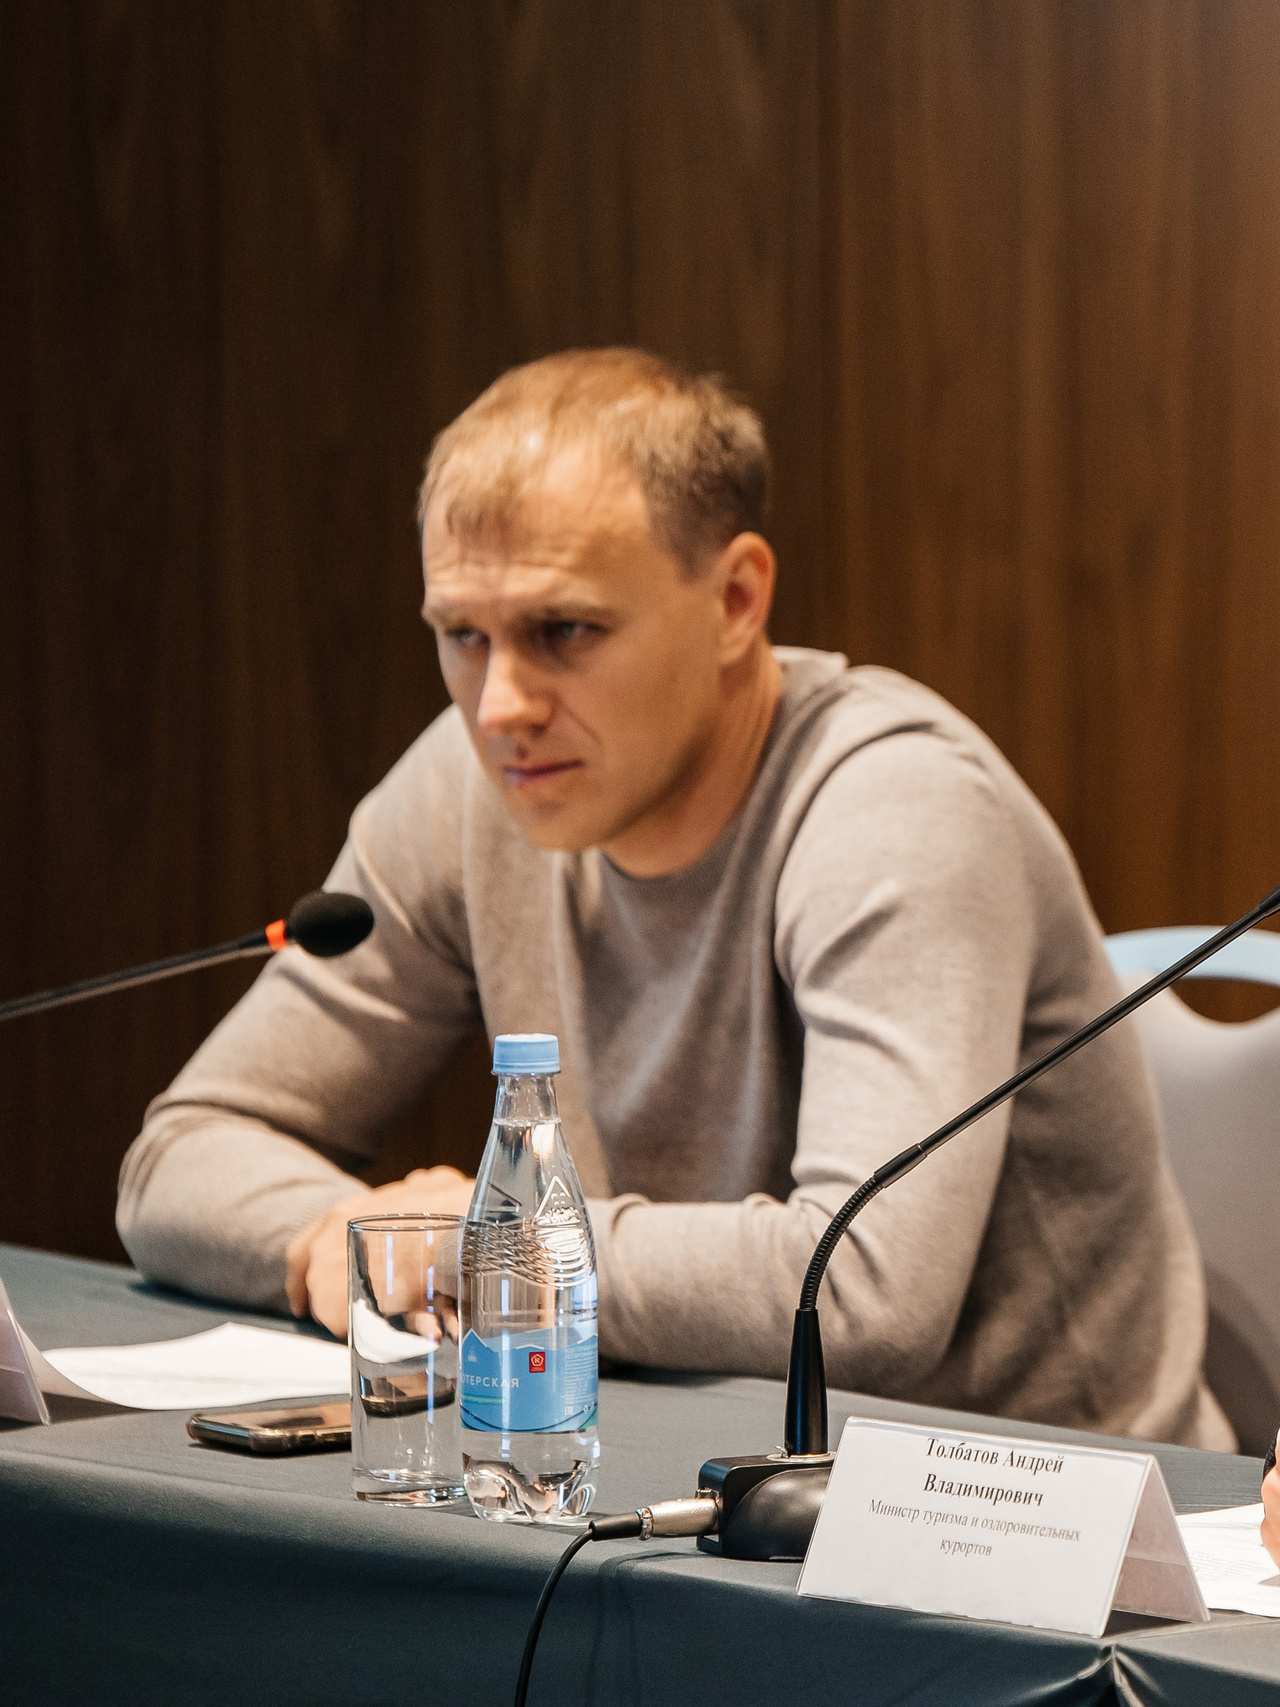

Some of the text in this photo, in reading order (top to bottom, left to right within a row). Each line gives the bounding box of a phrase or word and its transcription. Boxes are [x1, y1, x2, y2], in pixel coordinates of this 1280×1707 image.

[926, 1438, 1064, 1476] Толбатов Андрей
[923, 1473, 1043, 1506] Владимирович
[868, 1499, 1081, 1542] Министр туризма и оздоровительных
[940, 1538, 992, 1557] курортов
